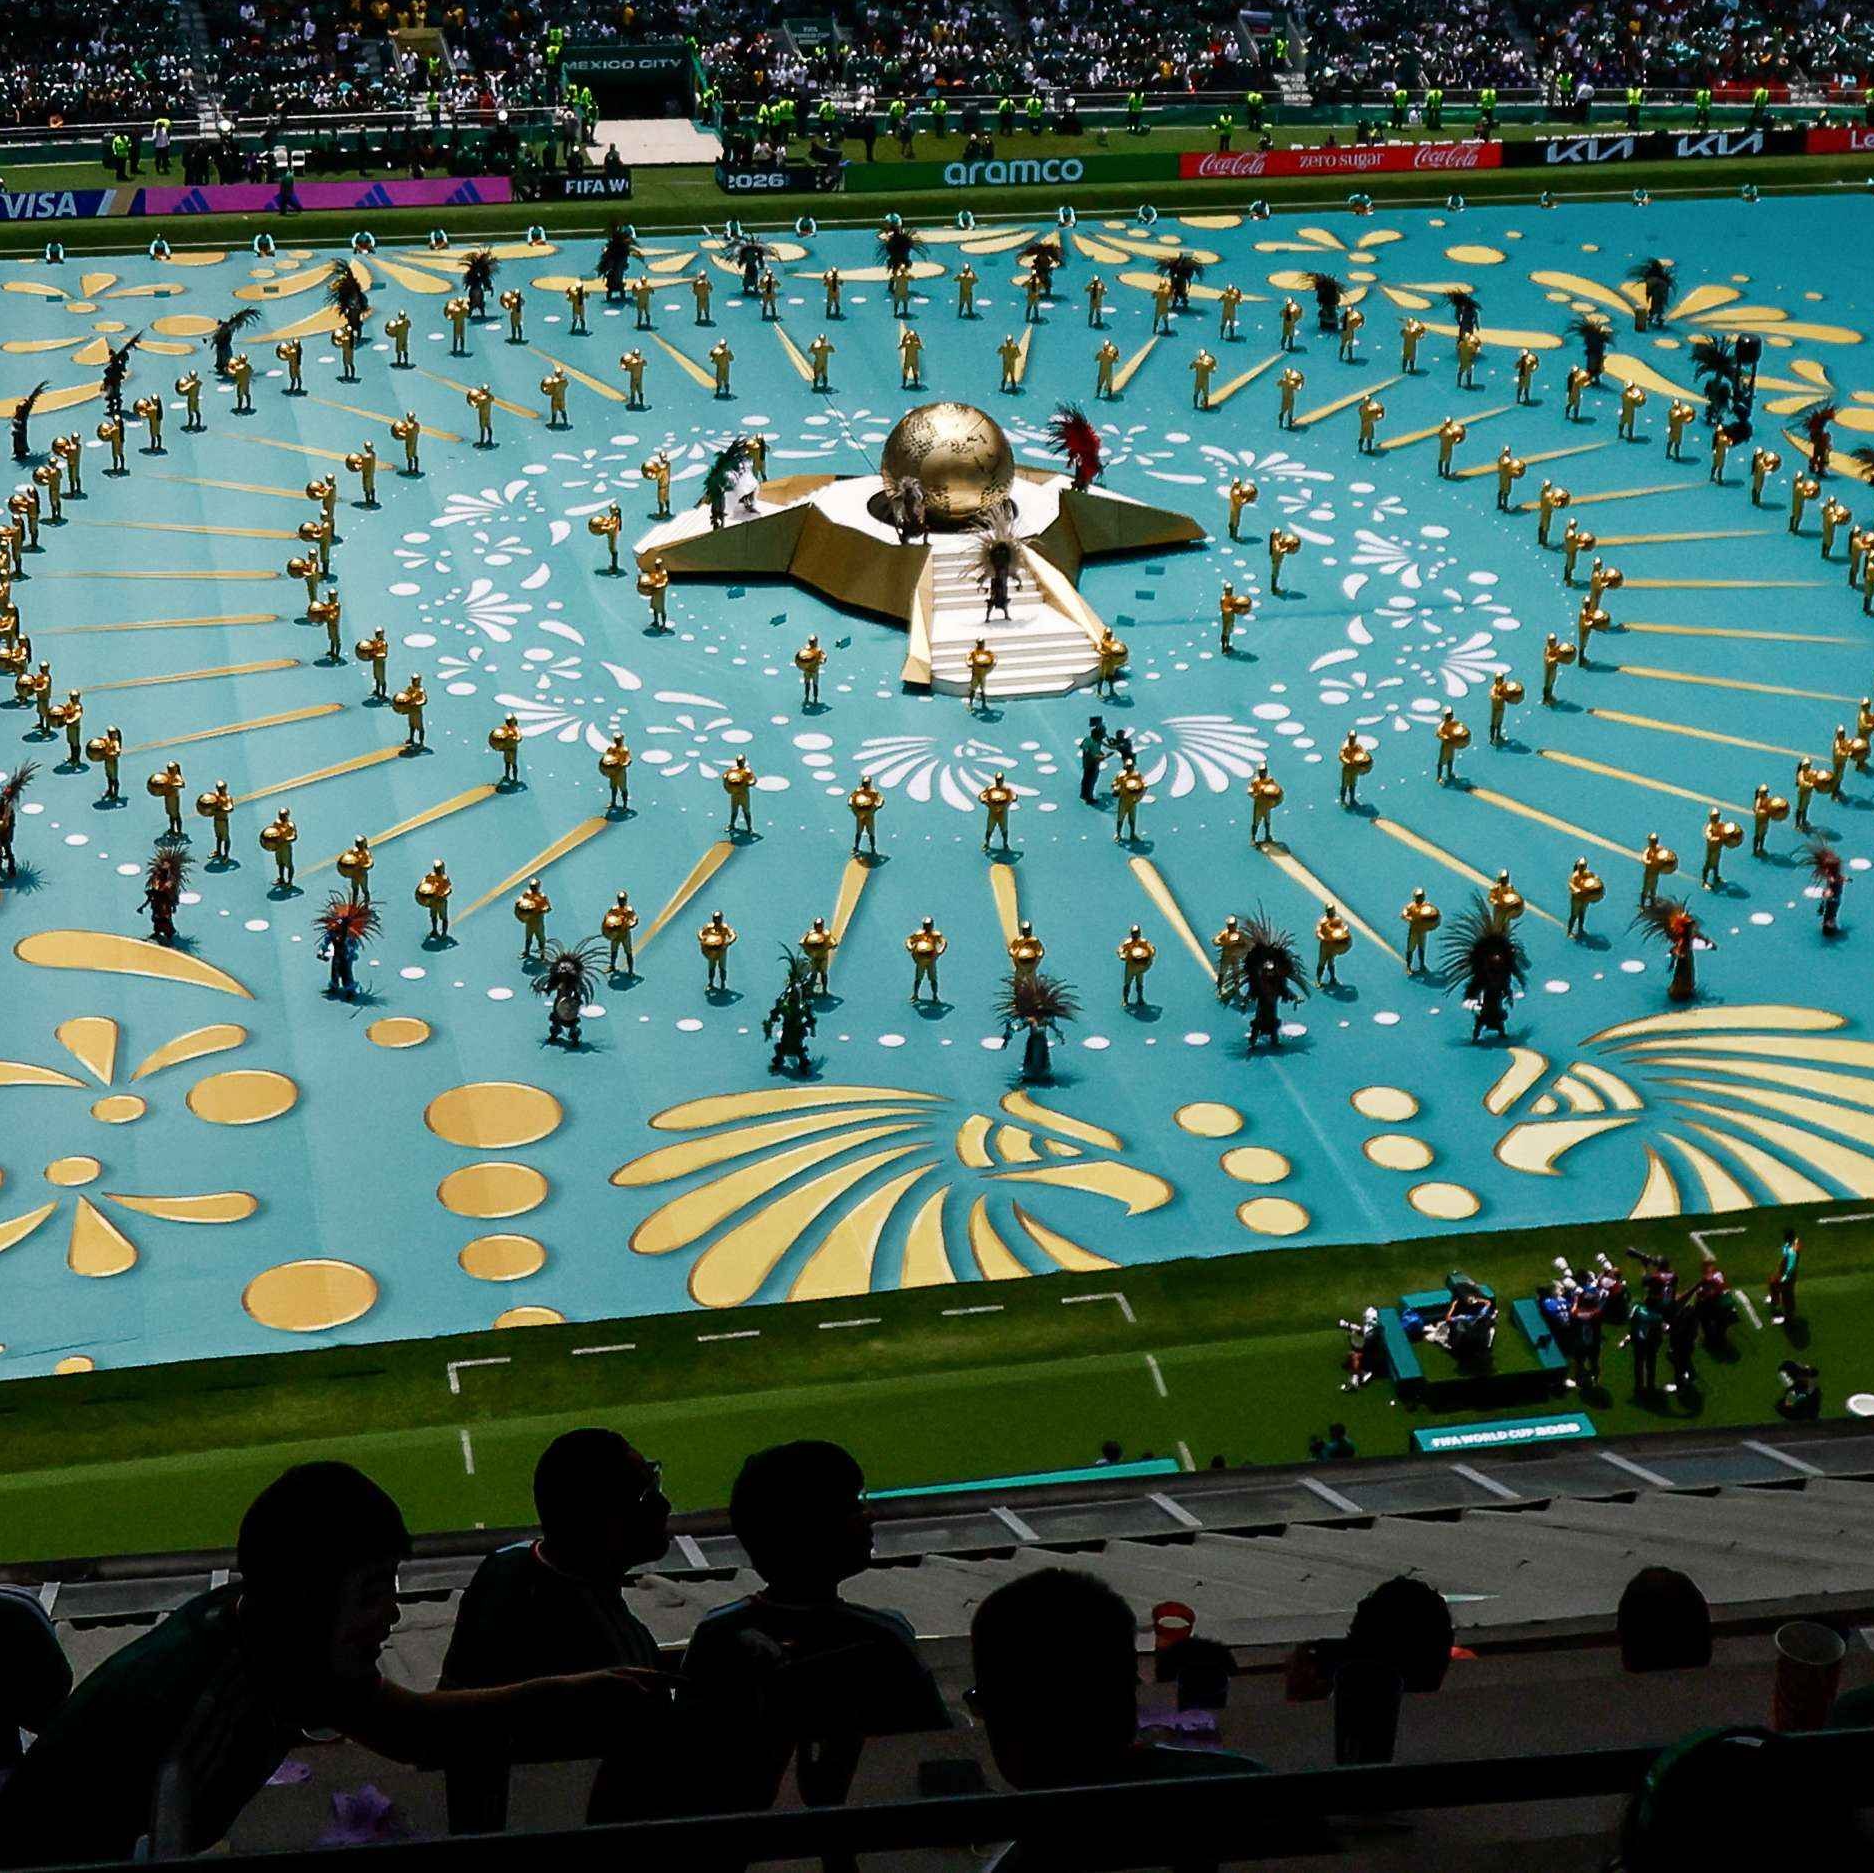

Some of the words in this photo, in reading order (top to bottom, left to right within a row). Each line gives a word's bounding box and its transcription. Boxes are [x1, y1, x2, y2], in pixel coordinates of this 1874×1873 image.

[1546, 136, 1634, 164] KIA
[1677, 131, 1764, 158] KIA
[944, 158, 1084, 186] aramco
[1299, 153, 1337, 168] zero
[1339, 151, 1385, 170] sugar
[565, 178, 605, 194] FIFA
